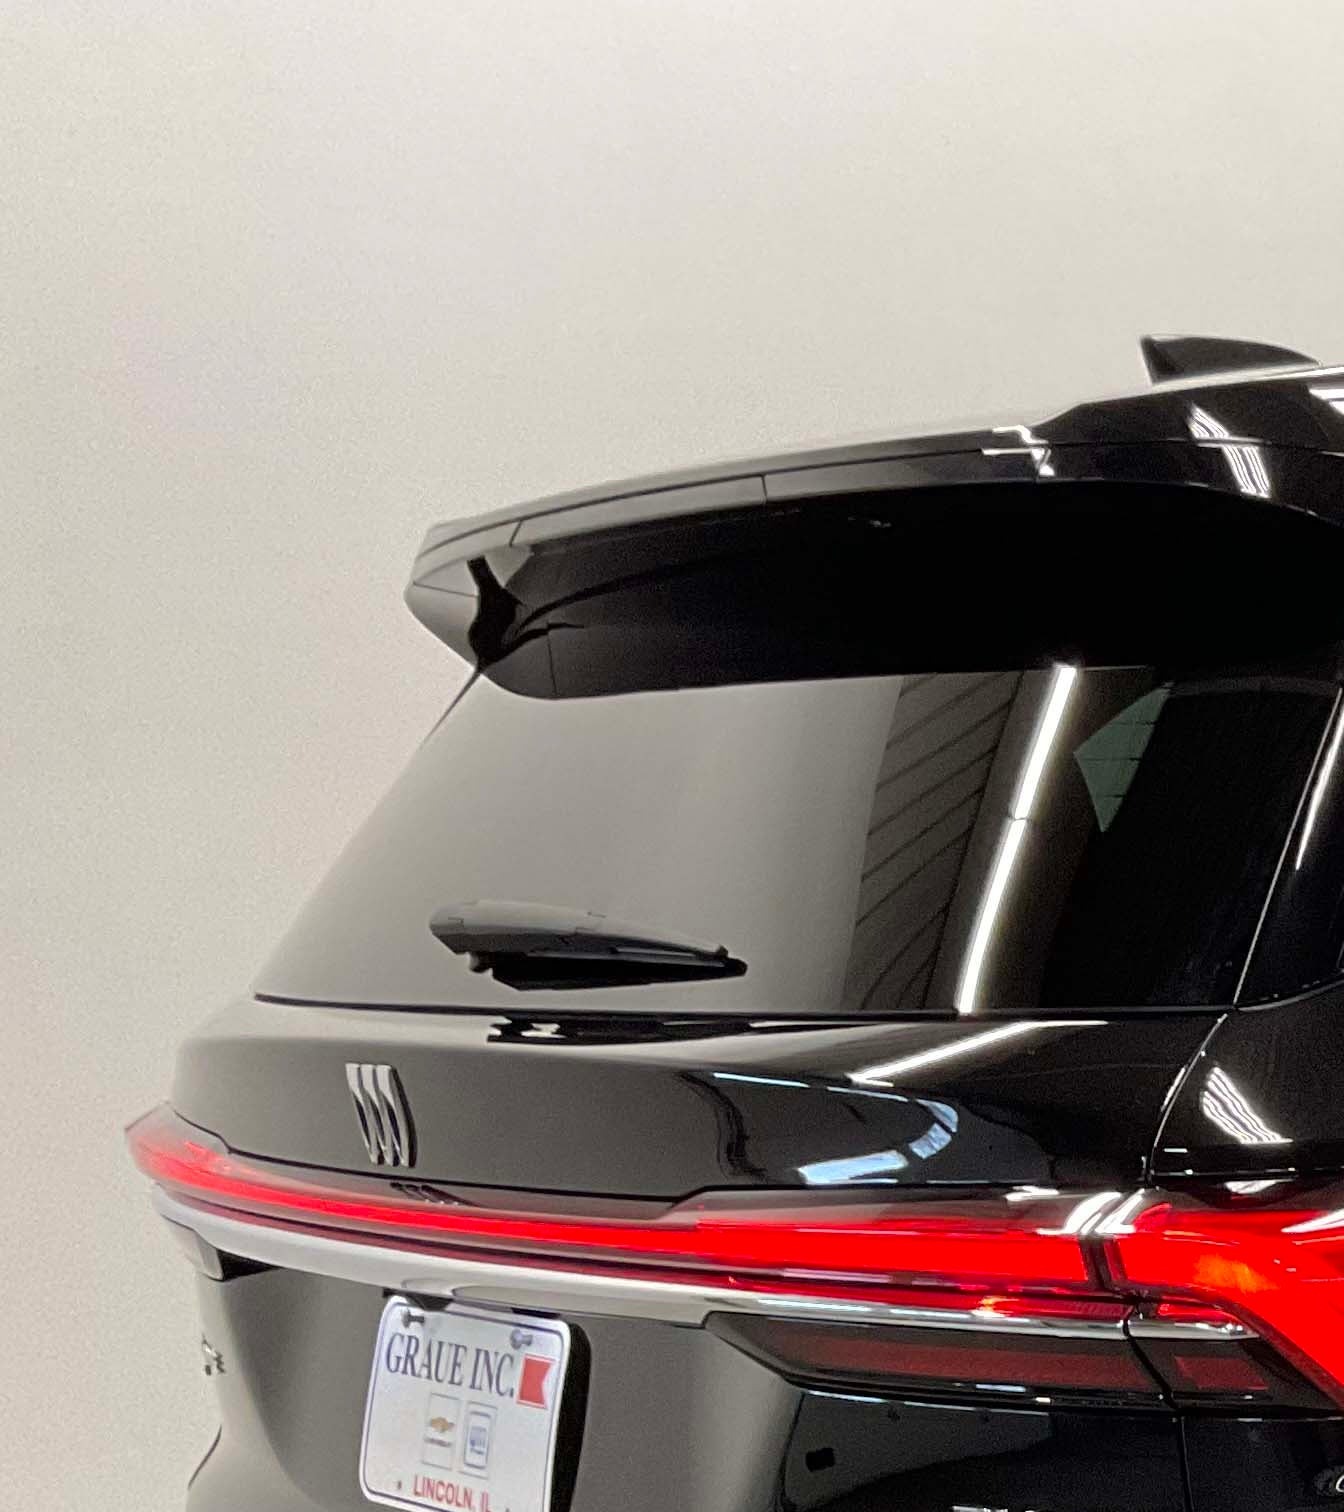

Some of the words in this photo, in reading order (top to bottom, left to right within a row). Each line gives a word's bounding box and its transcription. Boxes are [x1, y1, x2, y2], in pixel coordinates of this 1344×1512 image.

[386, 1332, 468, 1386] GRAUE
[468, 1344, 515, 1399] INC.
[413, 1474, 476, 1512] LINCOLN,
